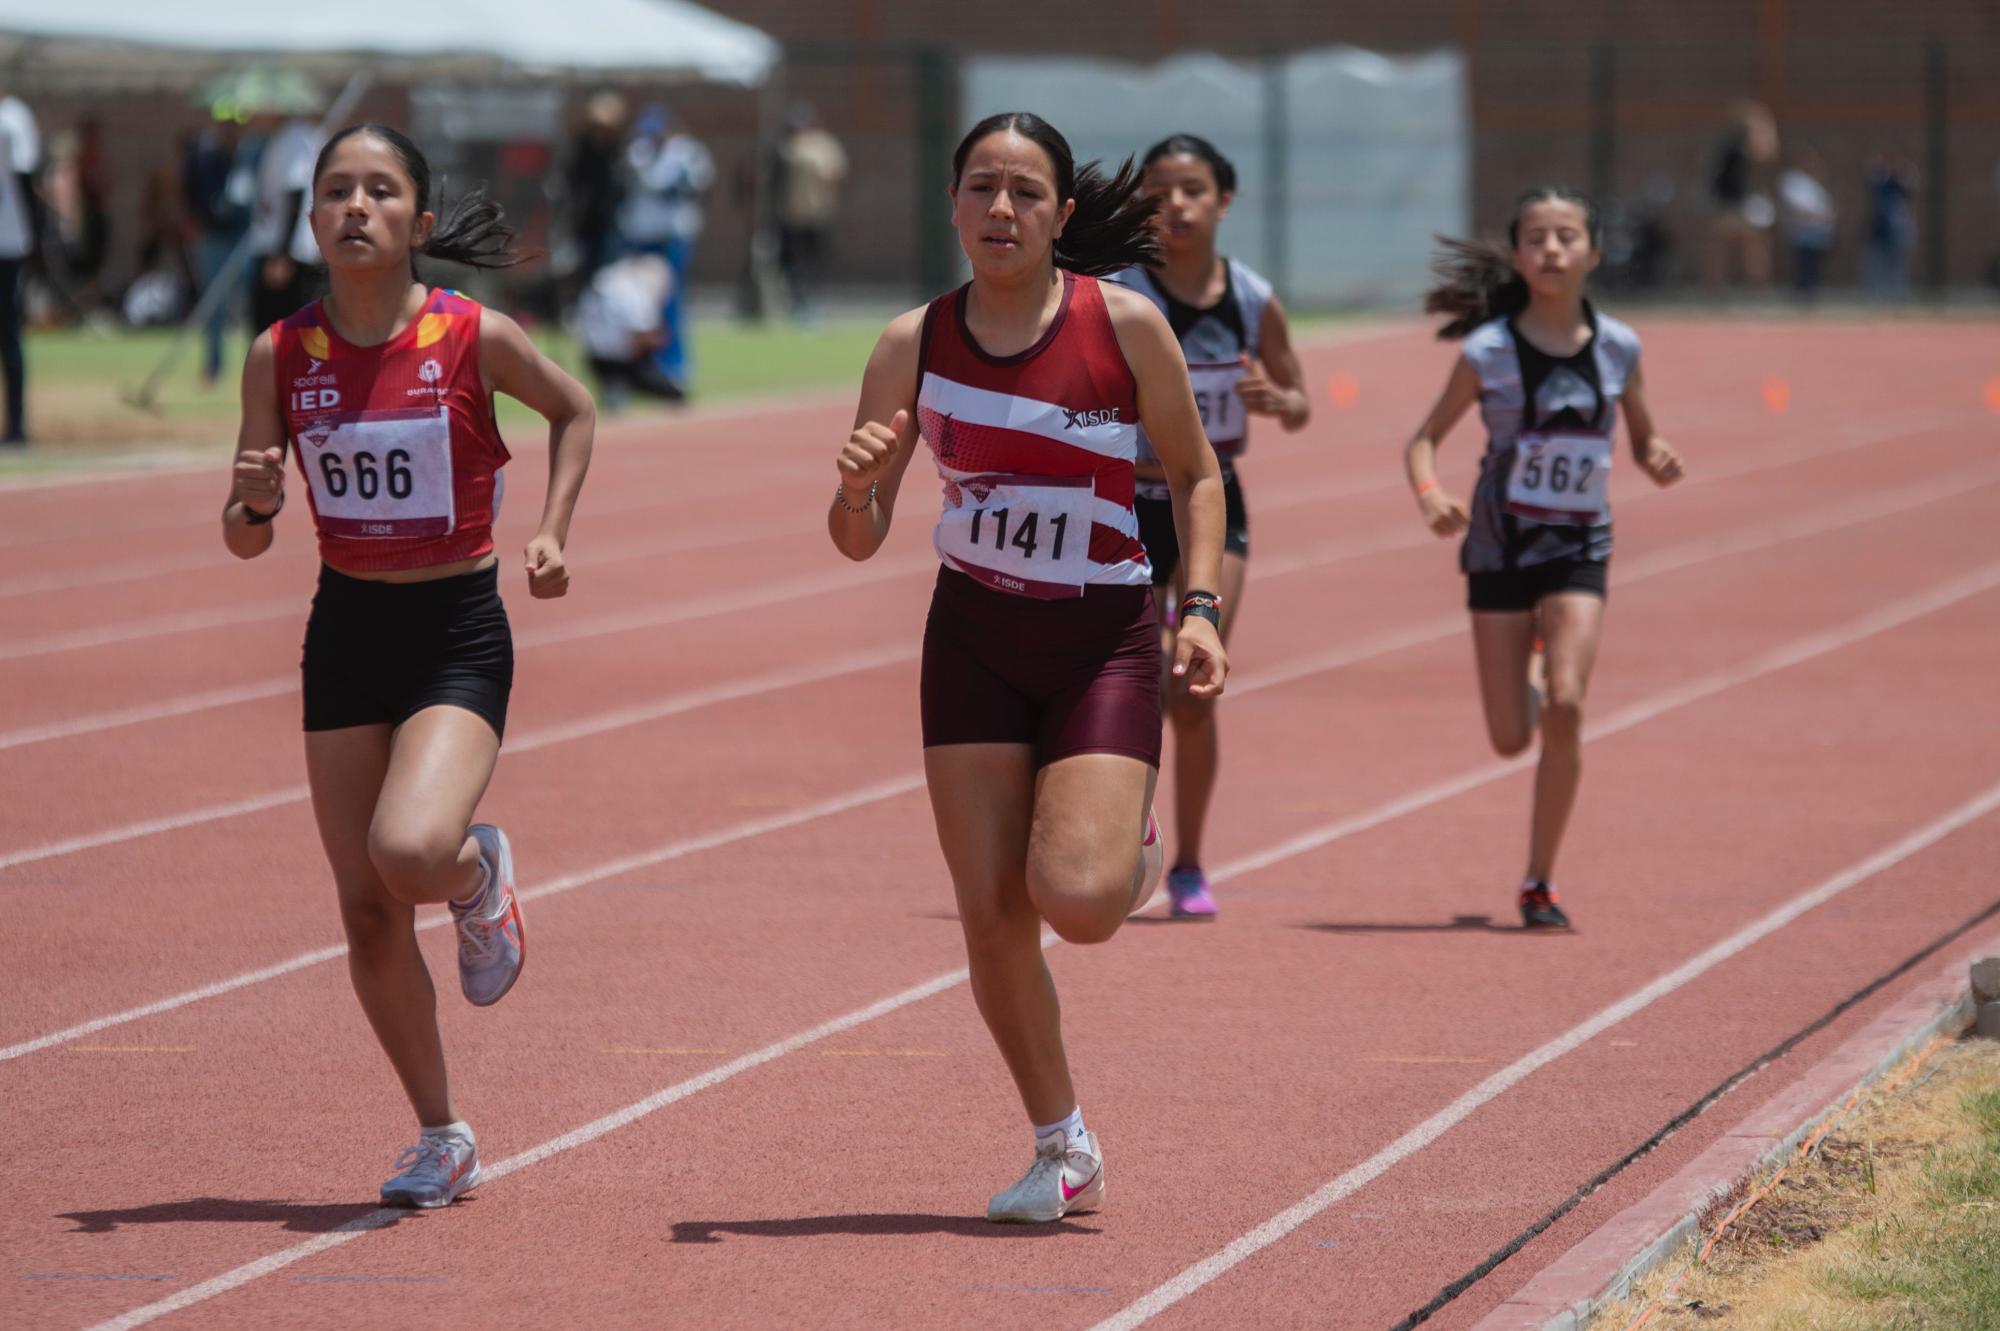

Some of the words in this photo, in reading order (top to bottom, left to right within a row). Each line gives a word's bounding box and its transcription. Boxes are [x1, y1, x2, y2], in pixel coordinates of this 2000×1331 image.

[291, 389, 341, 411] IED
[319, 448, 412, 500] 666
[1522, 454, 1595, 494] 562
[368, 524, 393, 535] ISDE
[970, 507, 1068, 560] 1141
[1001, 577, 1026, 592] ISDE
